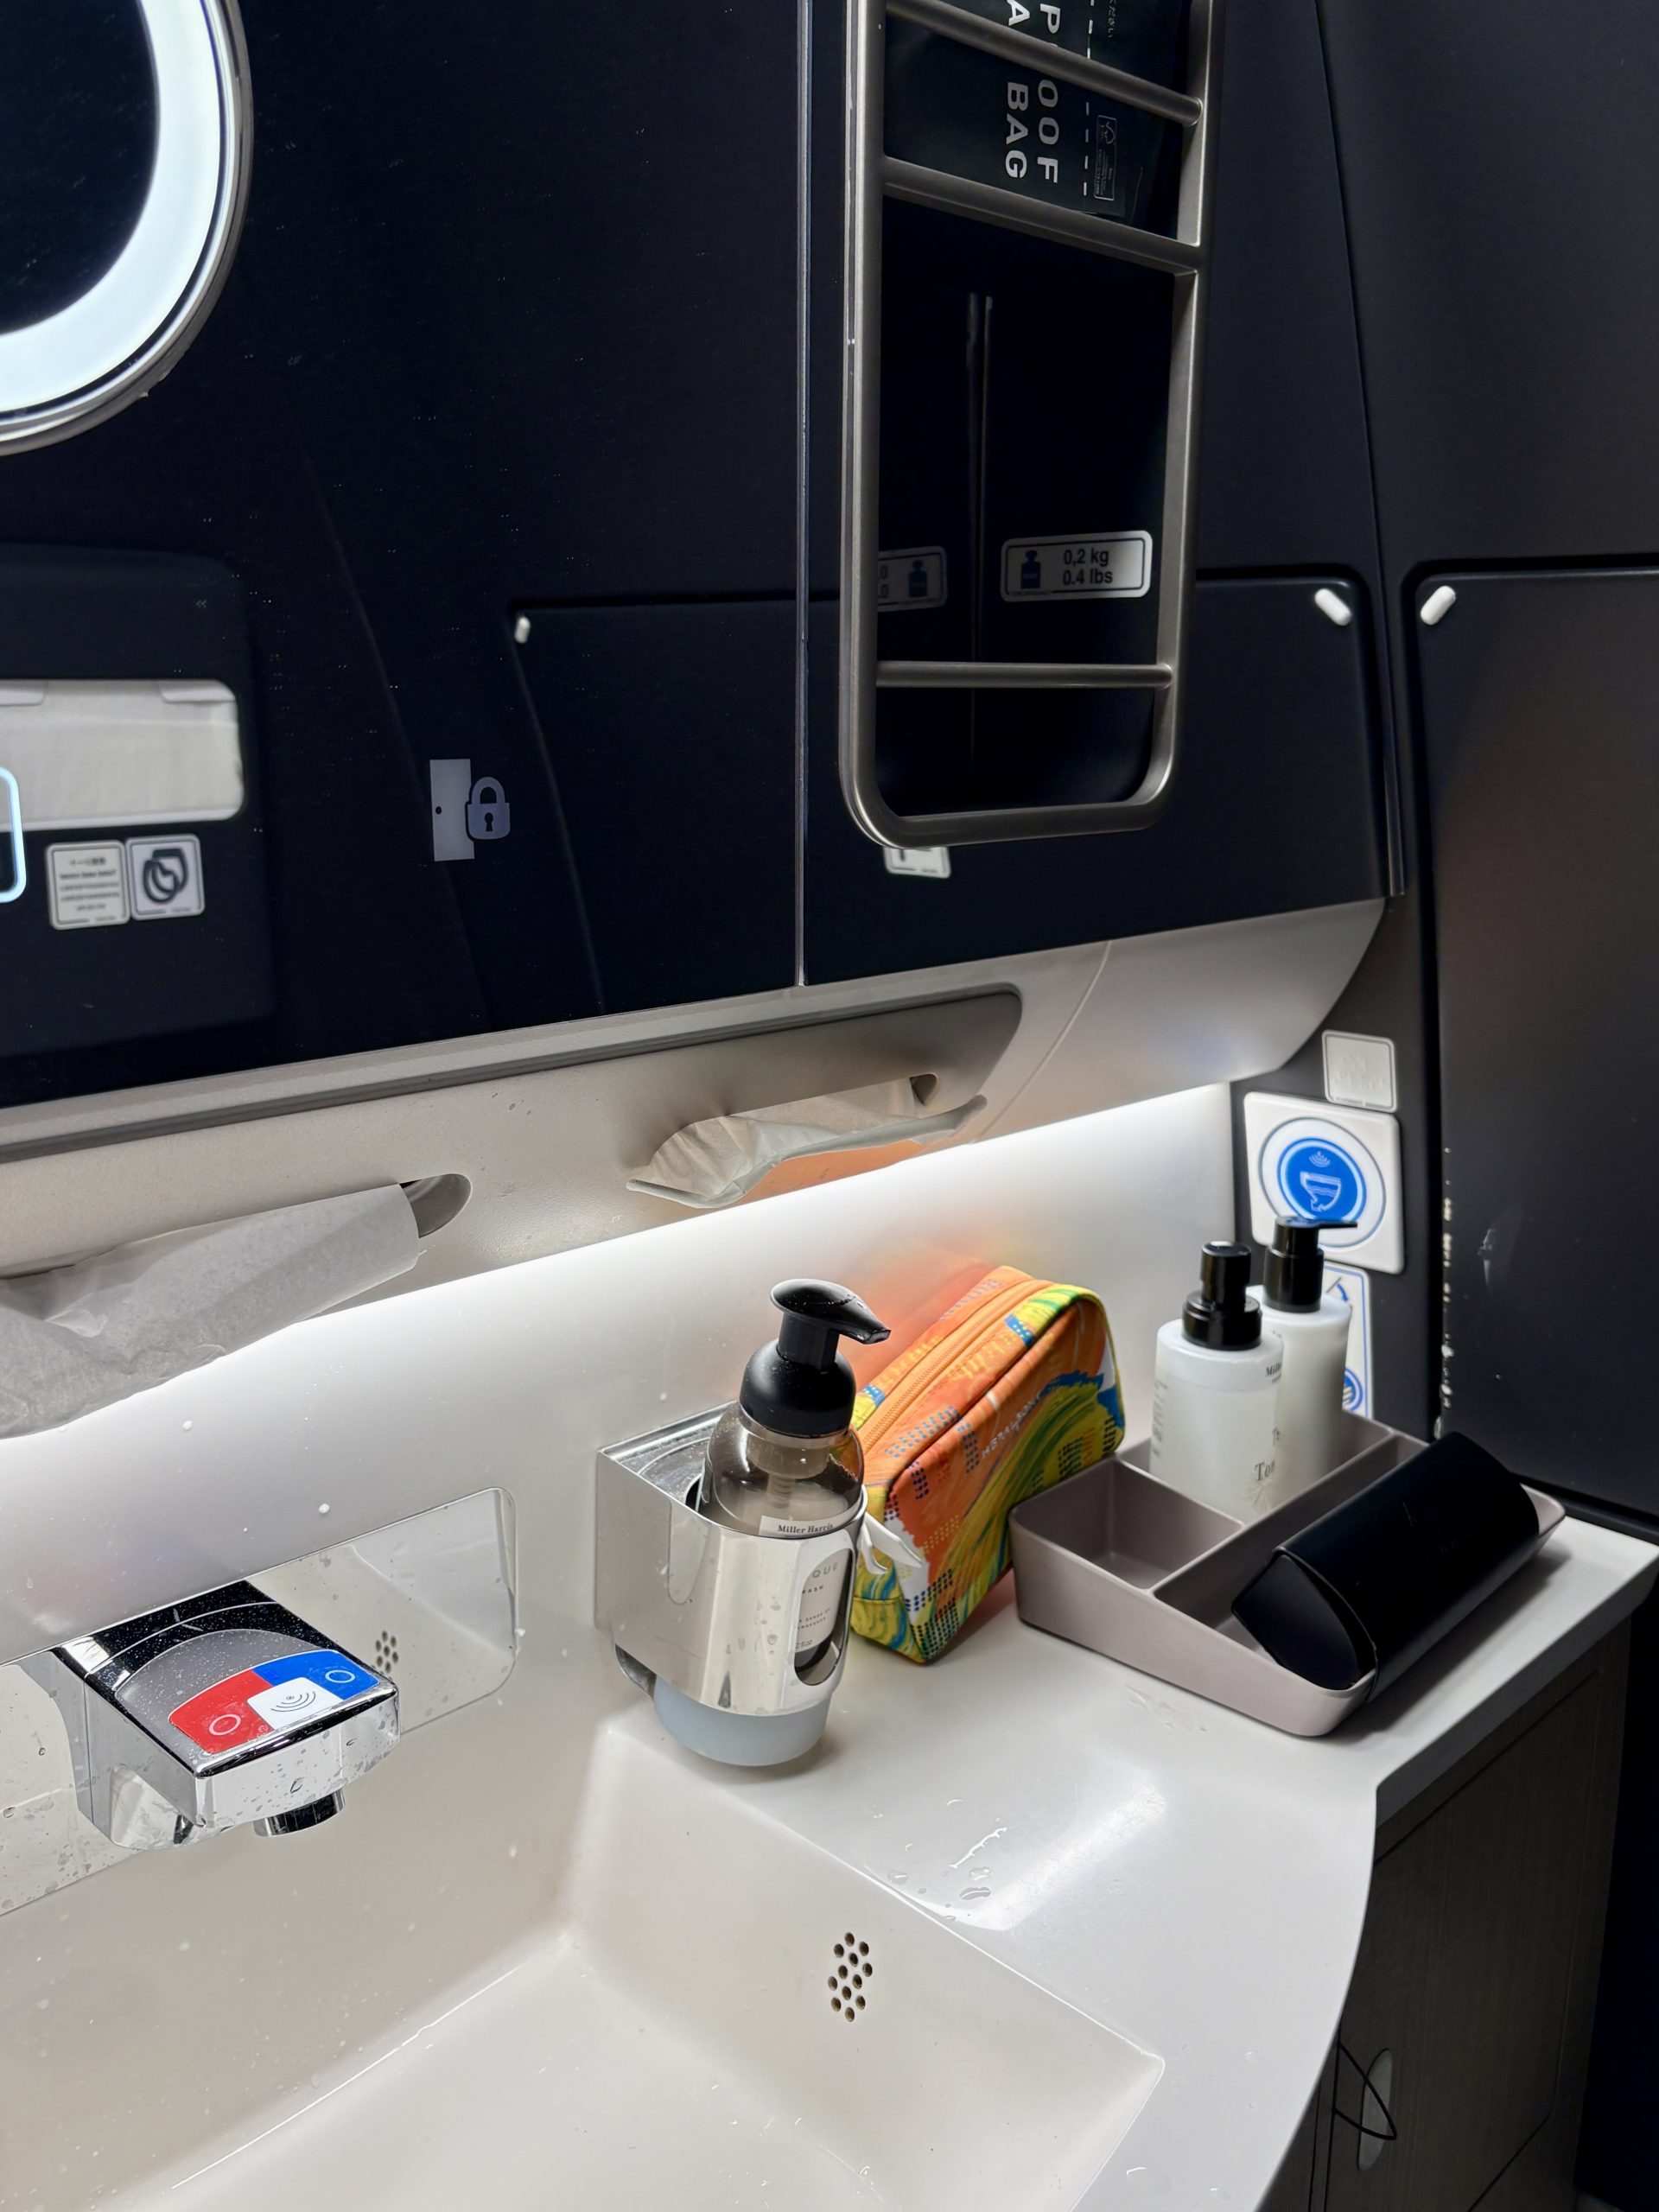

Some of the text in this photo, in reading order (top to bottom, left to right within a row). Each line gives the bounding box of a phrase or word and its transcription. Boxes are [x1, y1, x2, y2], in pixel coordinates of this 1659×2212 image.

[1005, 81, 1029, 179] BAG
[1064, 547, 1109, 567] 0,2 kg
[1063, 568, 1114, 586] 0.4 lbs
[778, 1523, 833, 1534] Miller Harris
